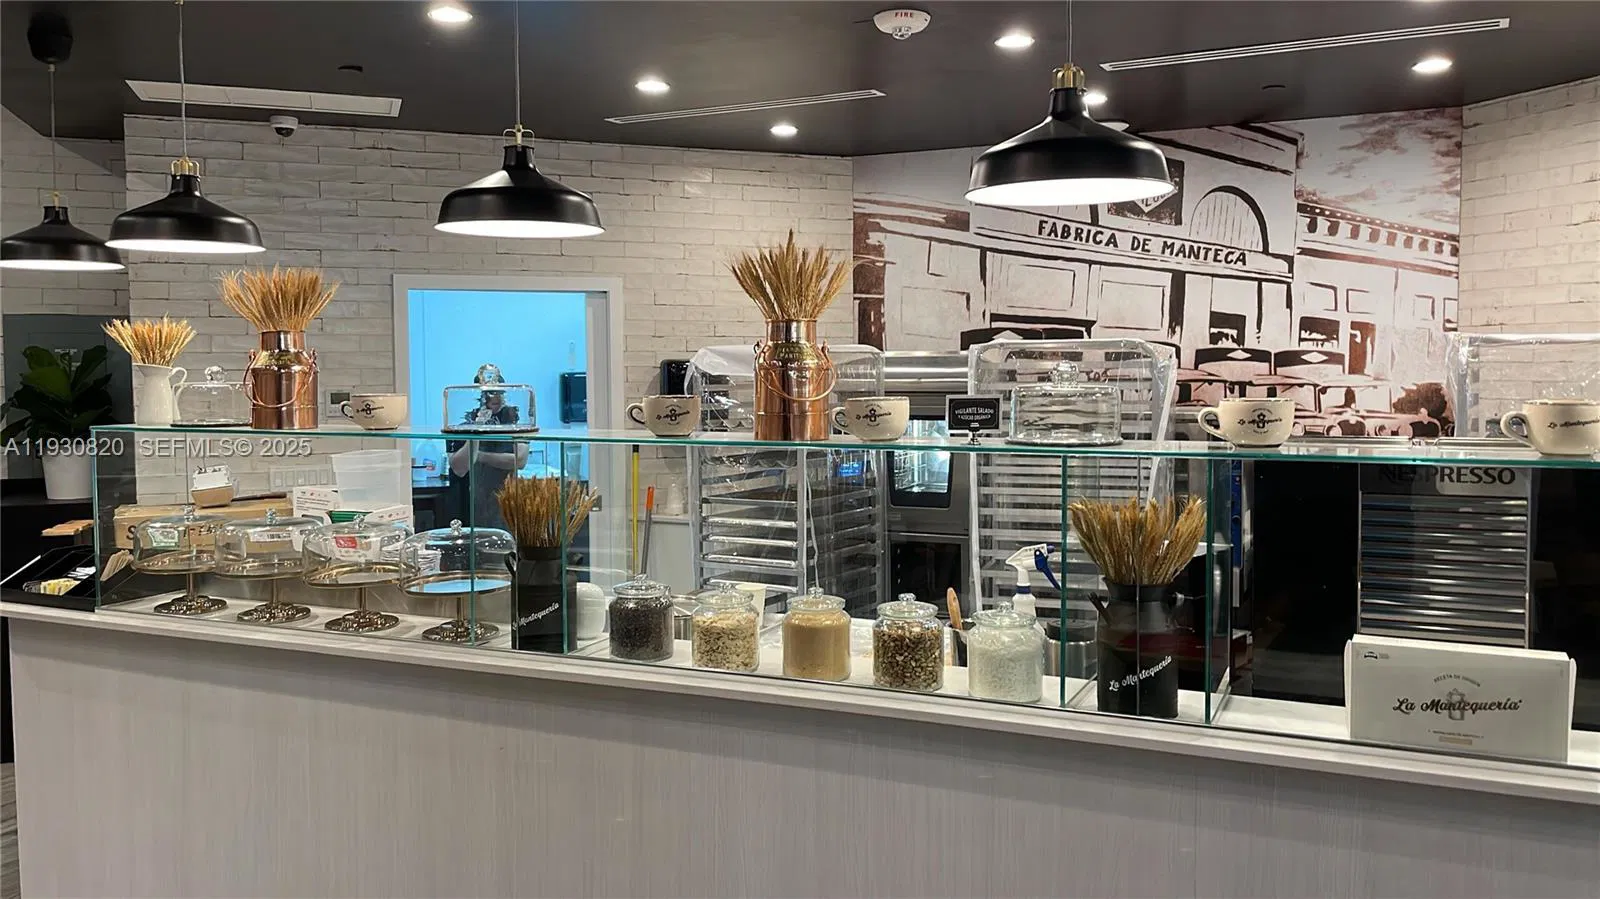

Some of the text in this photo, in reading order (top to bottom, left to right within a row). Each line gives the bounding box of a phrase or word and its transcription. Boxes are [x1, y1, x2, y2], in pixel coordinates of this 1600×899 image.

[1038, 220, 1247, 266] FABRICA DE MANTECA
[1379, 465, 1516, 485] NESPRESSO
[1109, 680, 1119, 691] La
[1393, 698, 1415, 715] La
